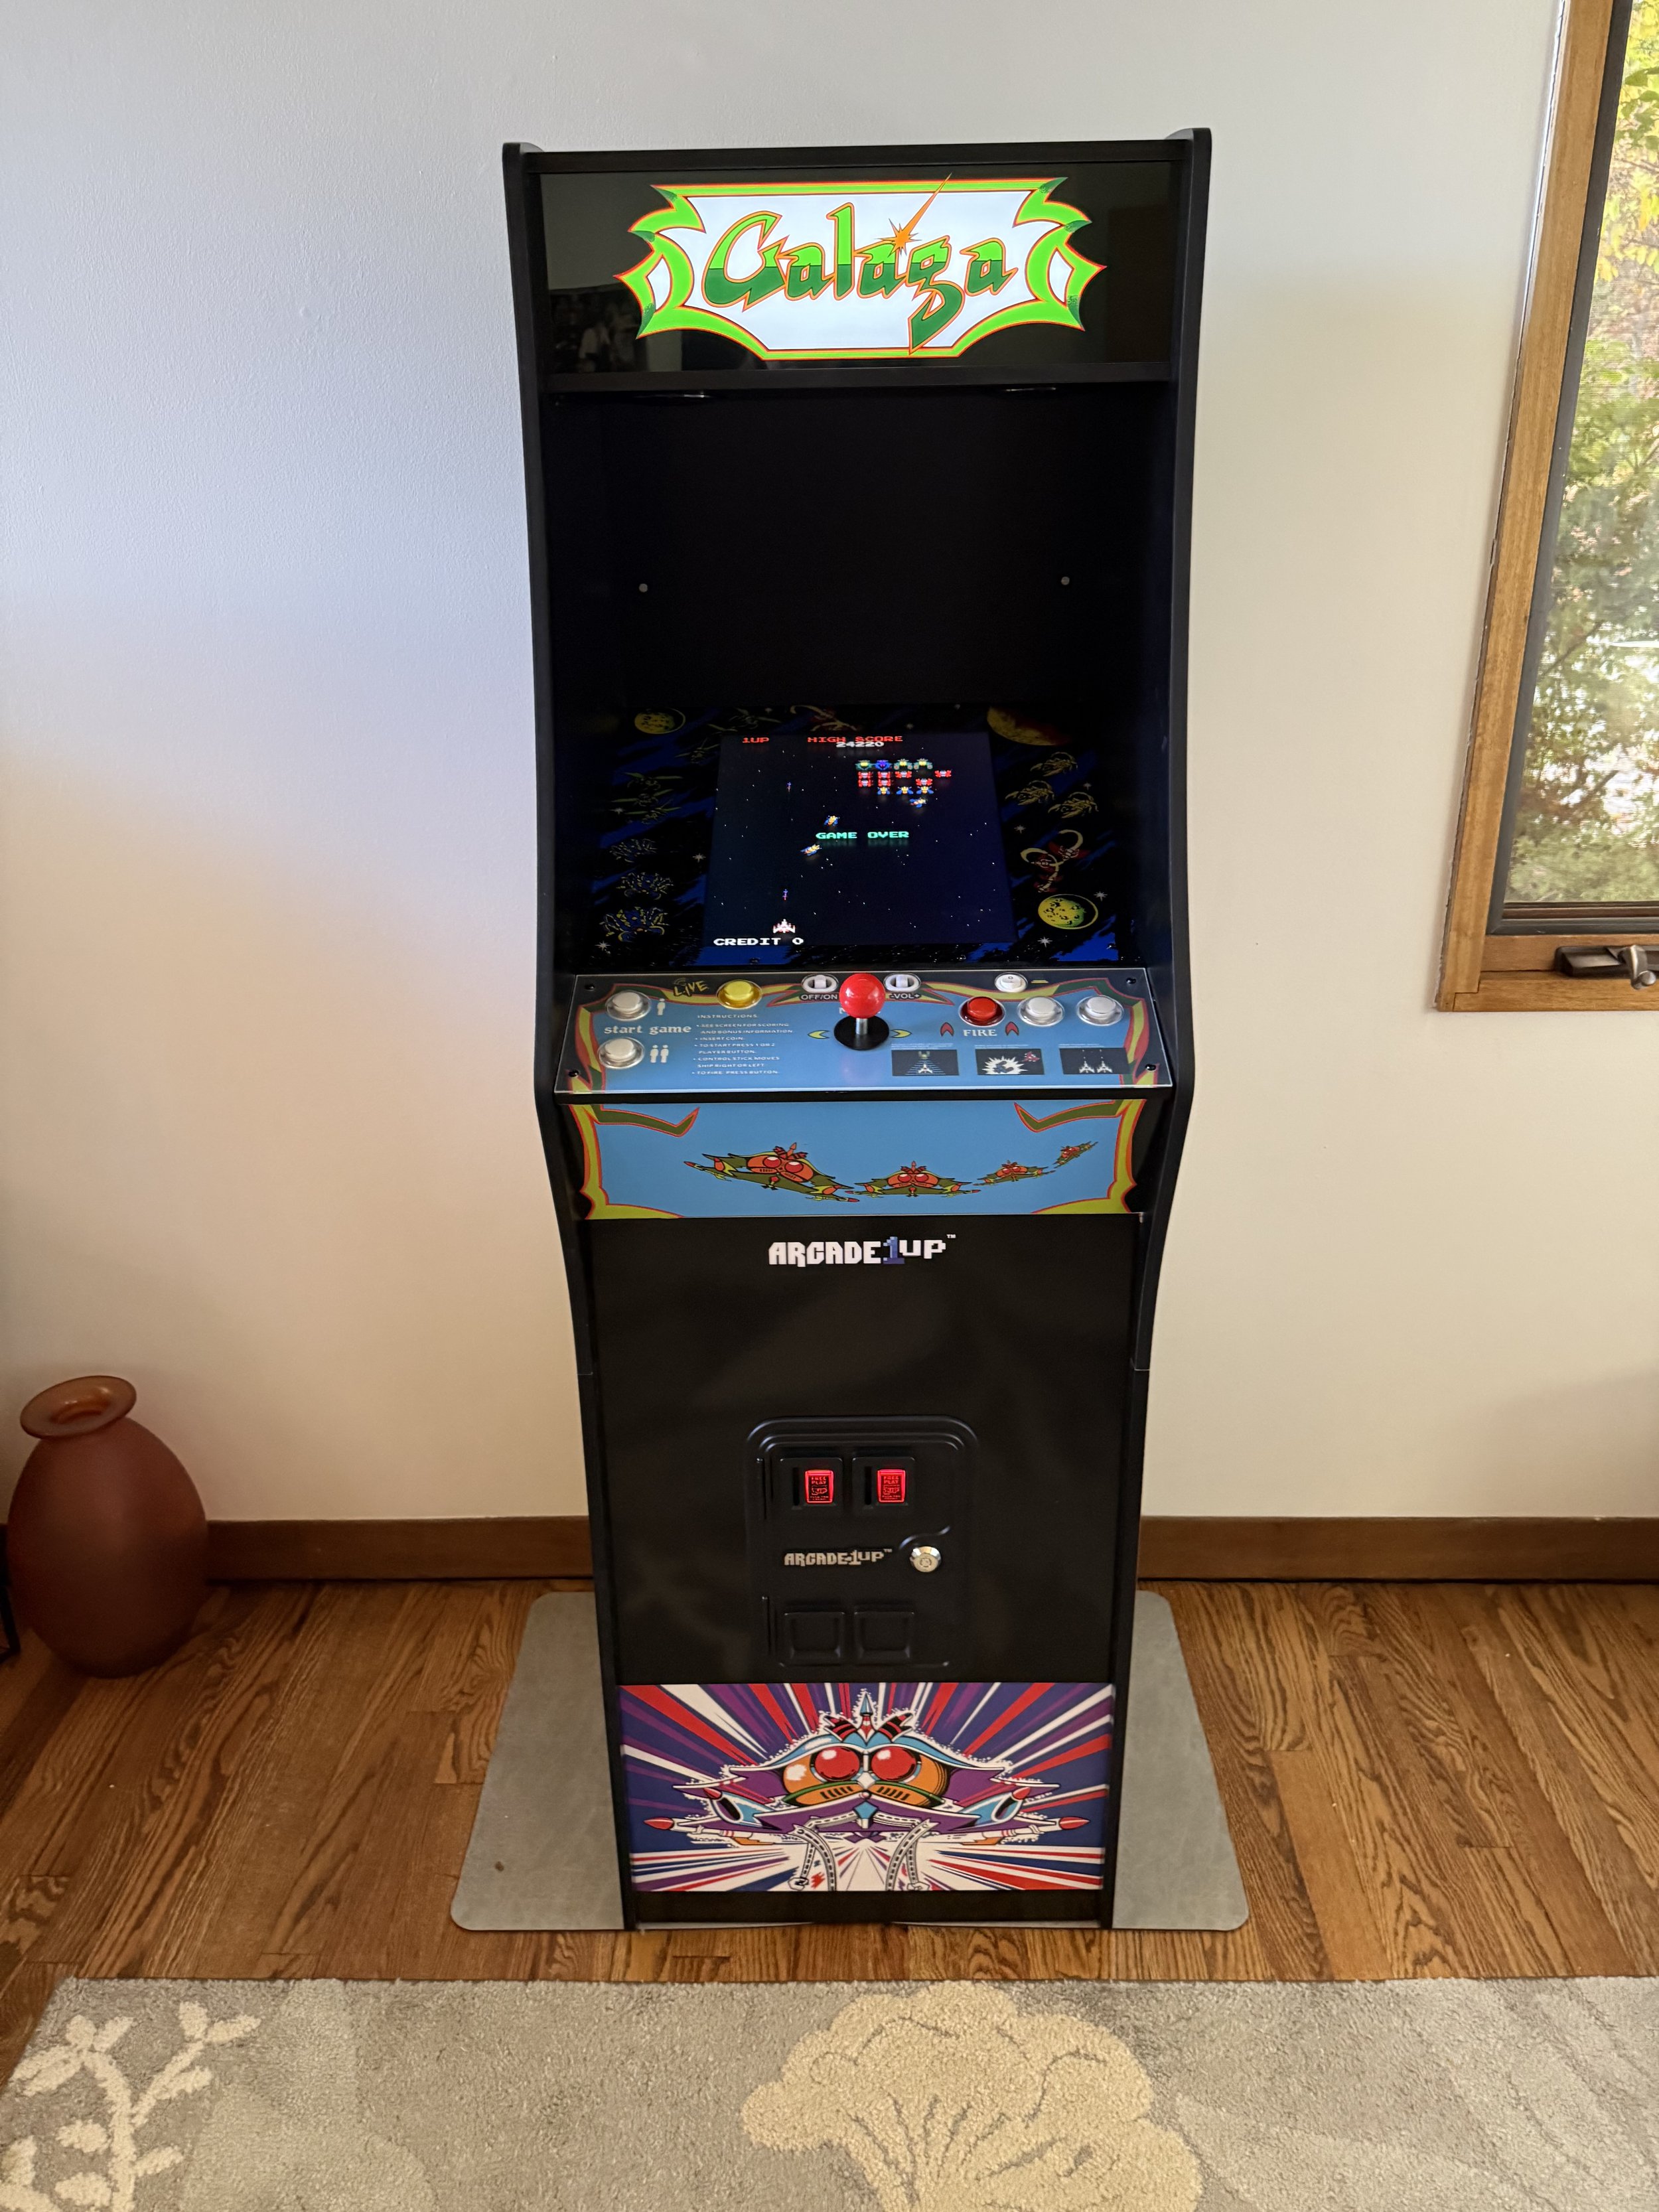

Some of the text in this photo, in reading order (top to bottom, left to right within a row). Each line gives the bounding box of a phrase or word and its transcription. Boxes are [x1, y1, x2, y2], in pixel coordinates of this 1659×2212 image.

[703, 202, 1019, 355] Galaga
[713, 937, 782, 946] CREDIT
[674, 980, 709, 996] LIVE
[604, 1025, 692, 1035] start game
